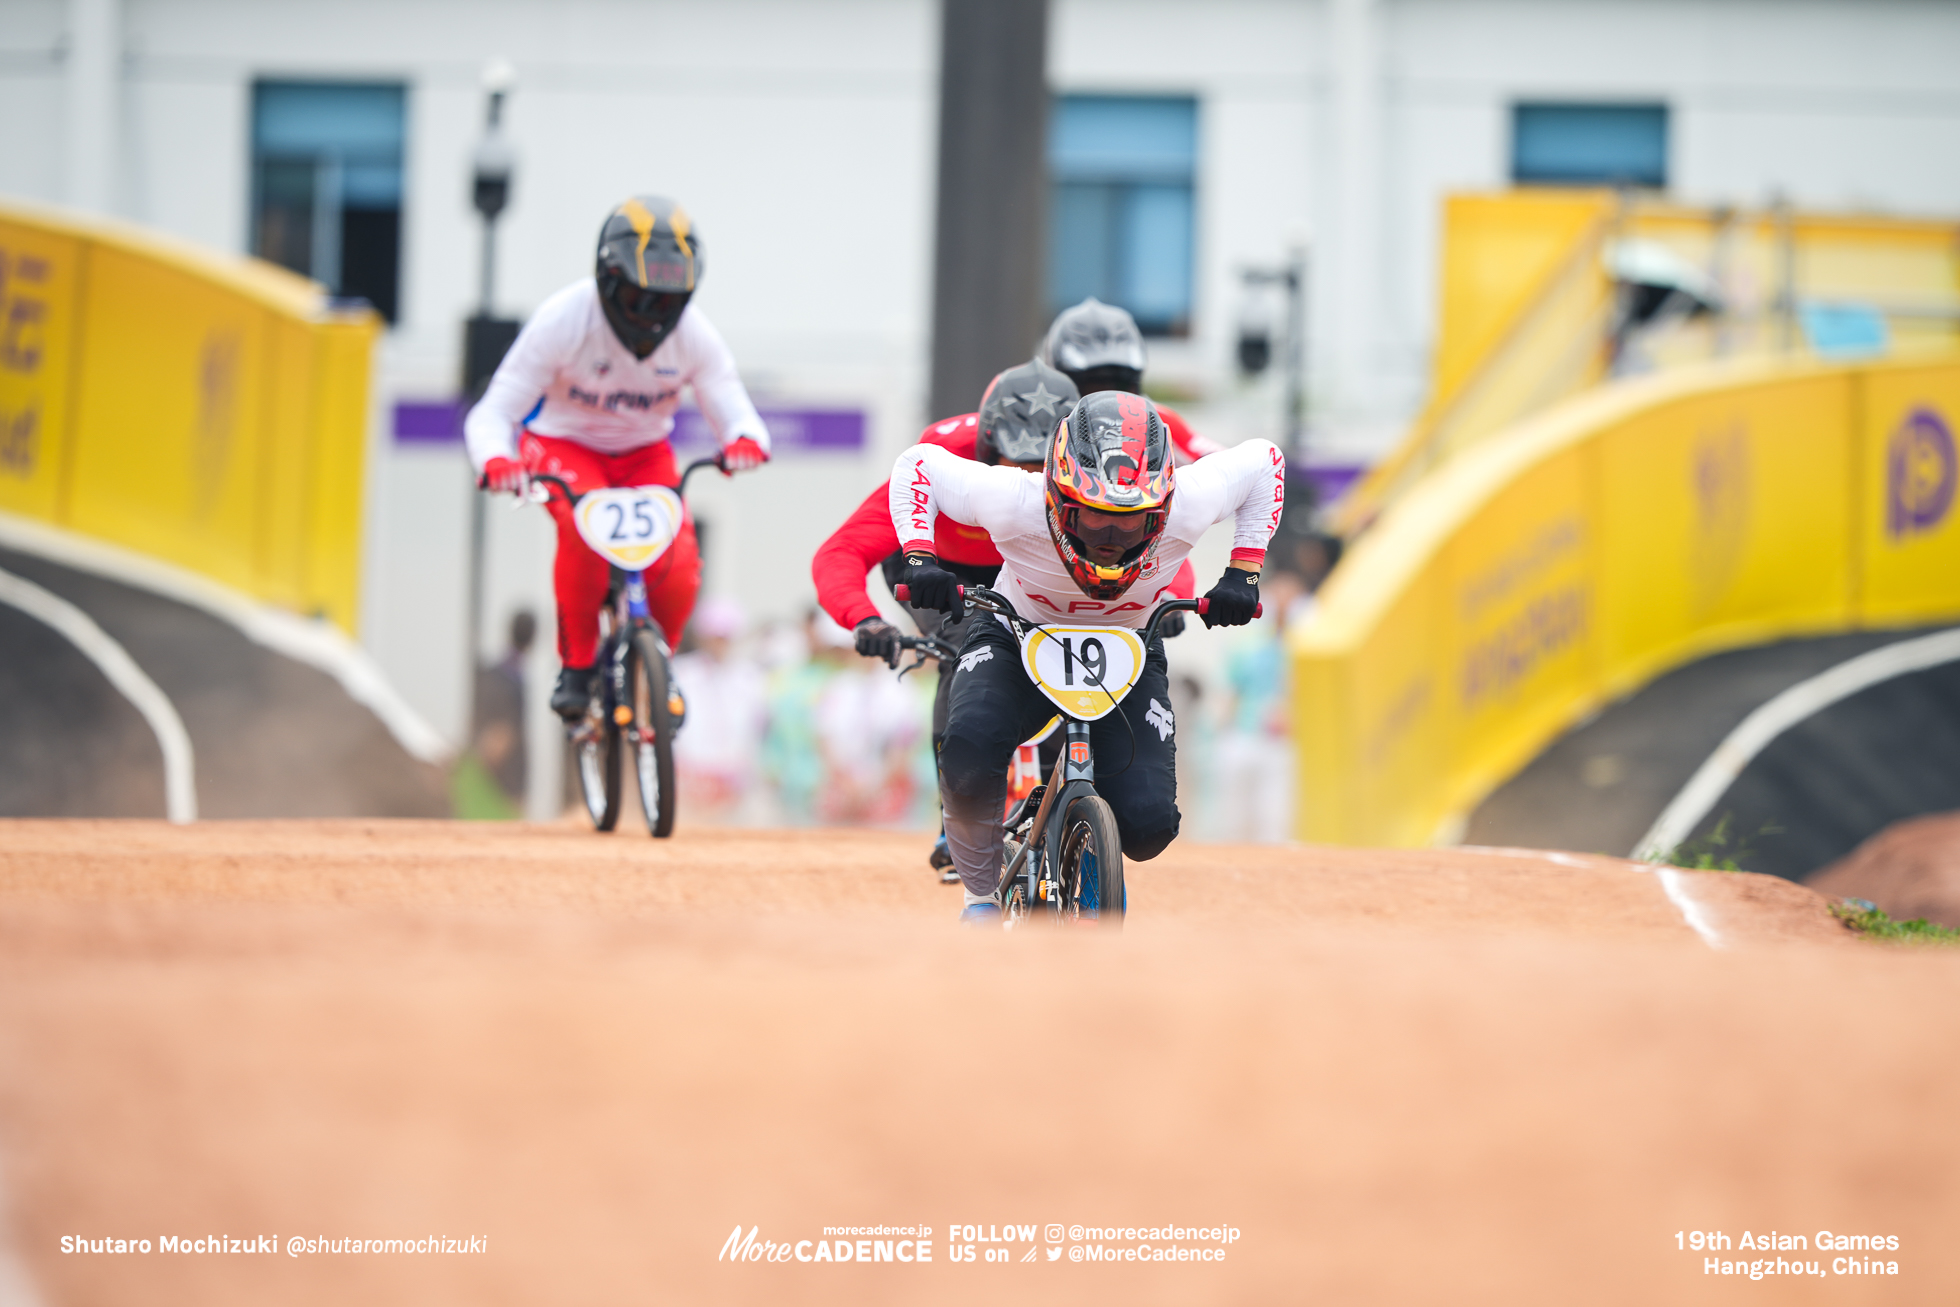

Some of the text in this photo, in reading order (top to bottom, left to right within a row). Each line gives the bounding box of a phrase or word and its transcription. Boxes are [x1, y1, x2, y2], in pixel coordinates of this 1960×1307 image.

[605, 500, 654, 541] 25
[1016, 578, 1170, 616] APA
[1062, 637, 1107, 687] 19
